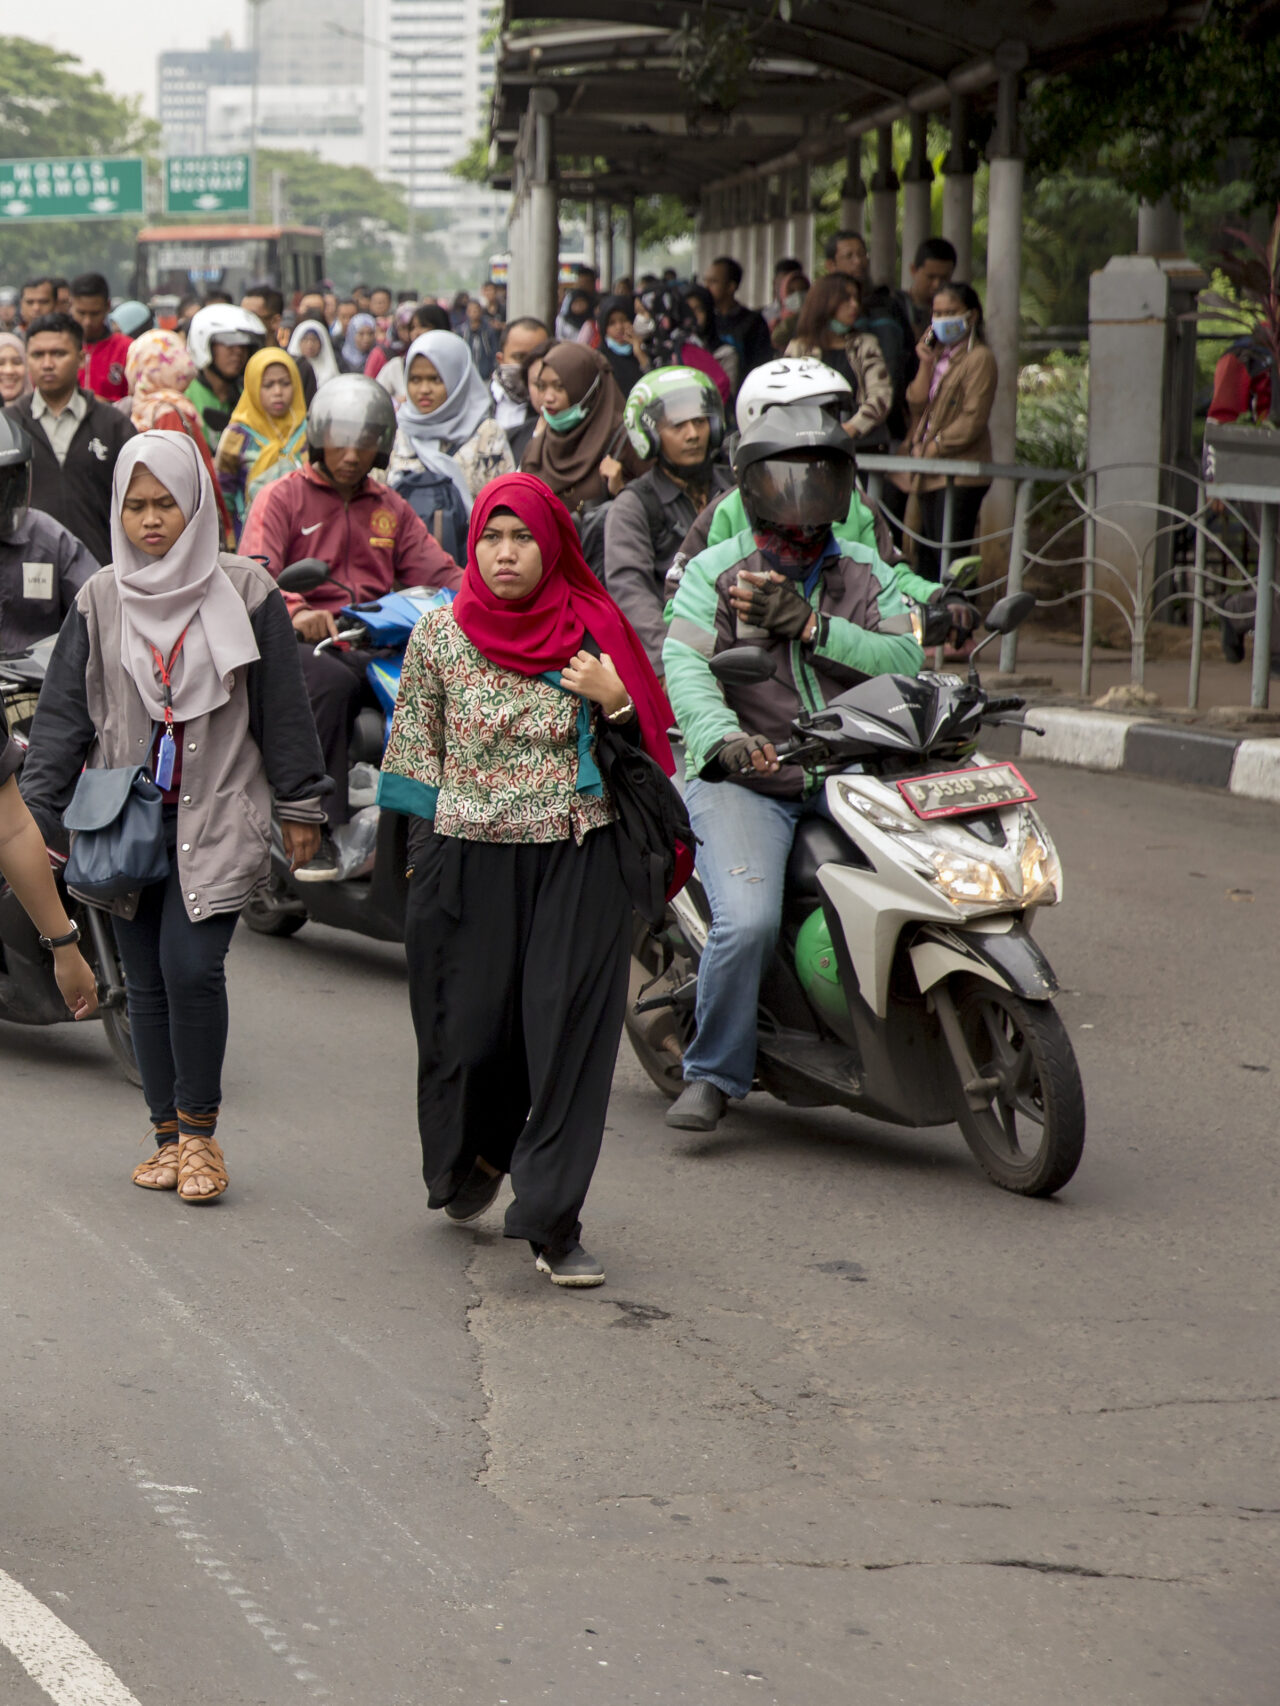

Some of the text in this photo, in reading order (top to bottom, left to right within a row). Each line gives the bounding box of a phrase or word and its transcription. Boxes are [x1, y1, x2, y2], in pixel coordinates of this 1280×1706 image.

[13, 161, 105, 181] MONAS
[0, 177, 119, 199] HARMONI
[169, 175, 245, 193] BUSWAY
[908, 784, 926, 801] B
[928, 777, 976, 797] 3539
